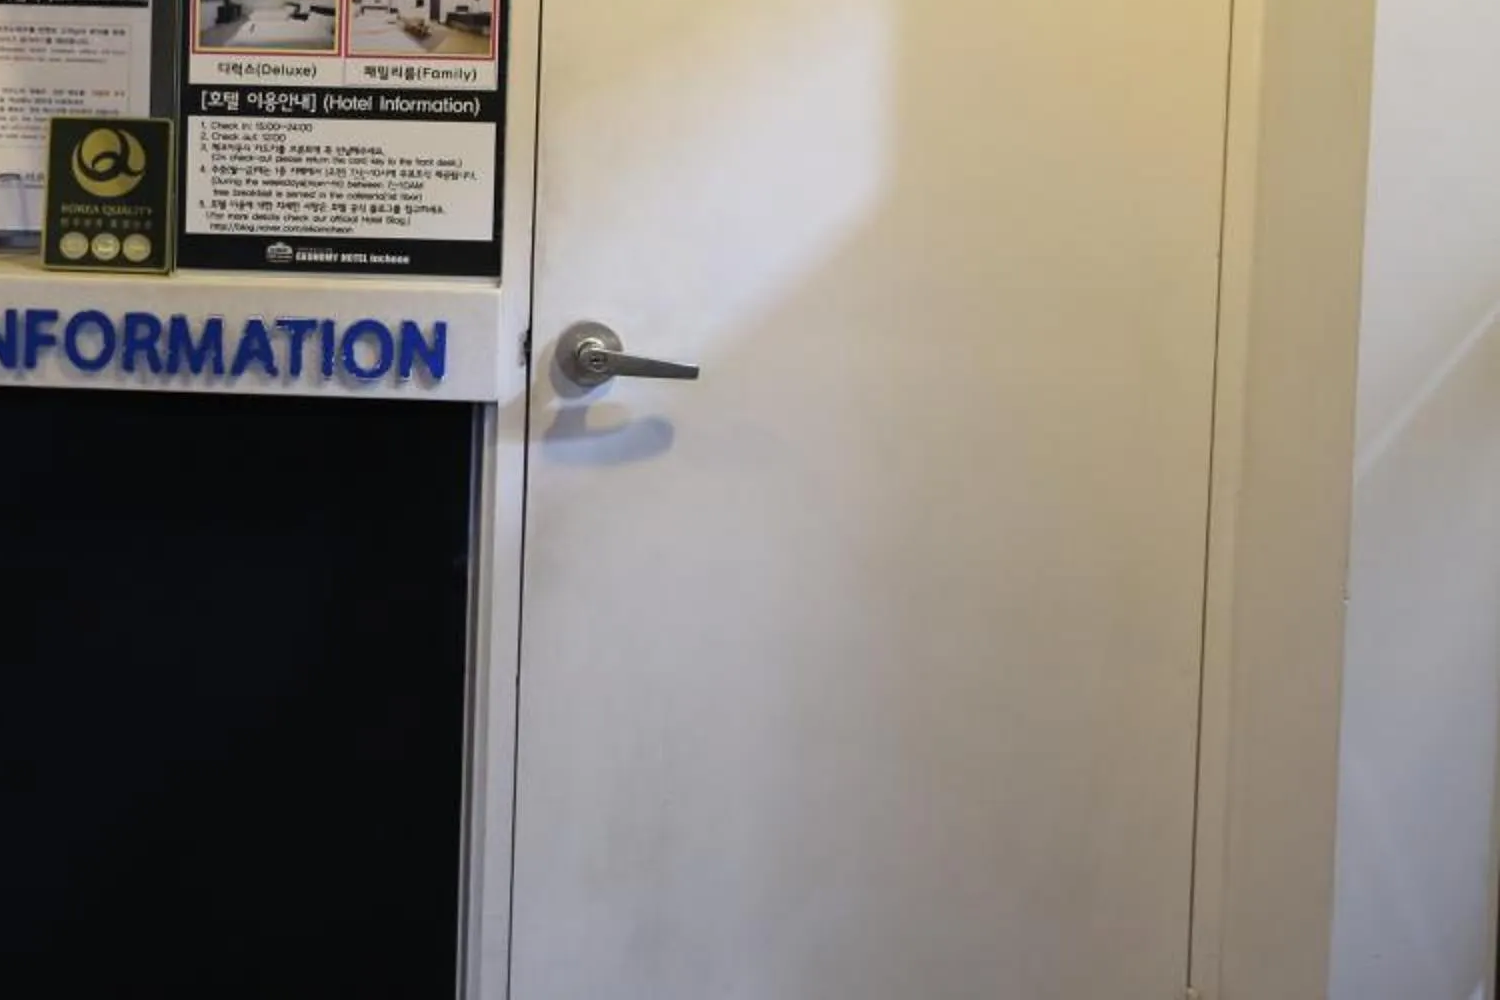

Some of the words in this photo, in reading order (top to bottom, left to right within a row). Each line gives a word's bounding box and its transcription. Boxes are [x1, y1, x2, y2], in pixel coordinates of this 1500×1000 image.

[217, 63, 317, 79] 디럭스(Deluxe)
[363, 65, 477, 83] 패밀리룸(Family)
[201, 92, 241, 112] [호텔
[247, 92, 317, 114] 이용안내]
[323, 96, 374, 114] (Hotel
[380, 96, 482, 117] Information)
[211, 121, 239, 131] Check
[211, 132, 239, 142] Check
[61, 202, 100, 215] KOREA
[102, 204, 153, 217] QUALITY
[295, 250, 339, 262] EKONOMY
[340, 252, 368, 264] HOTEL
